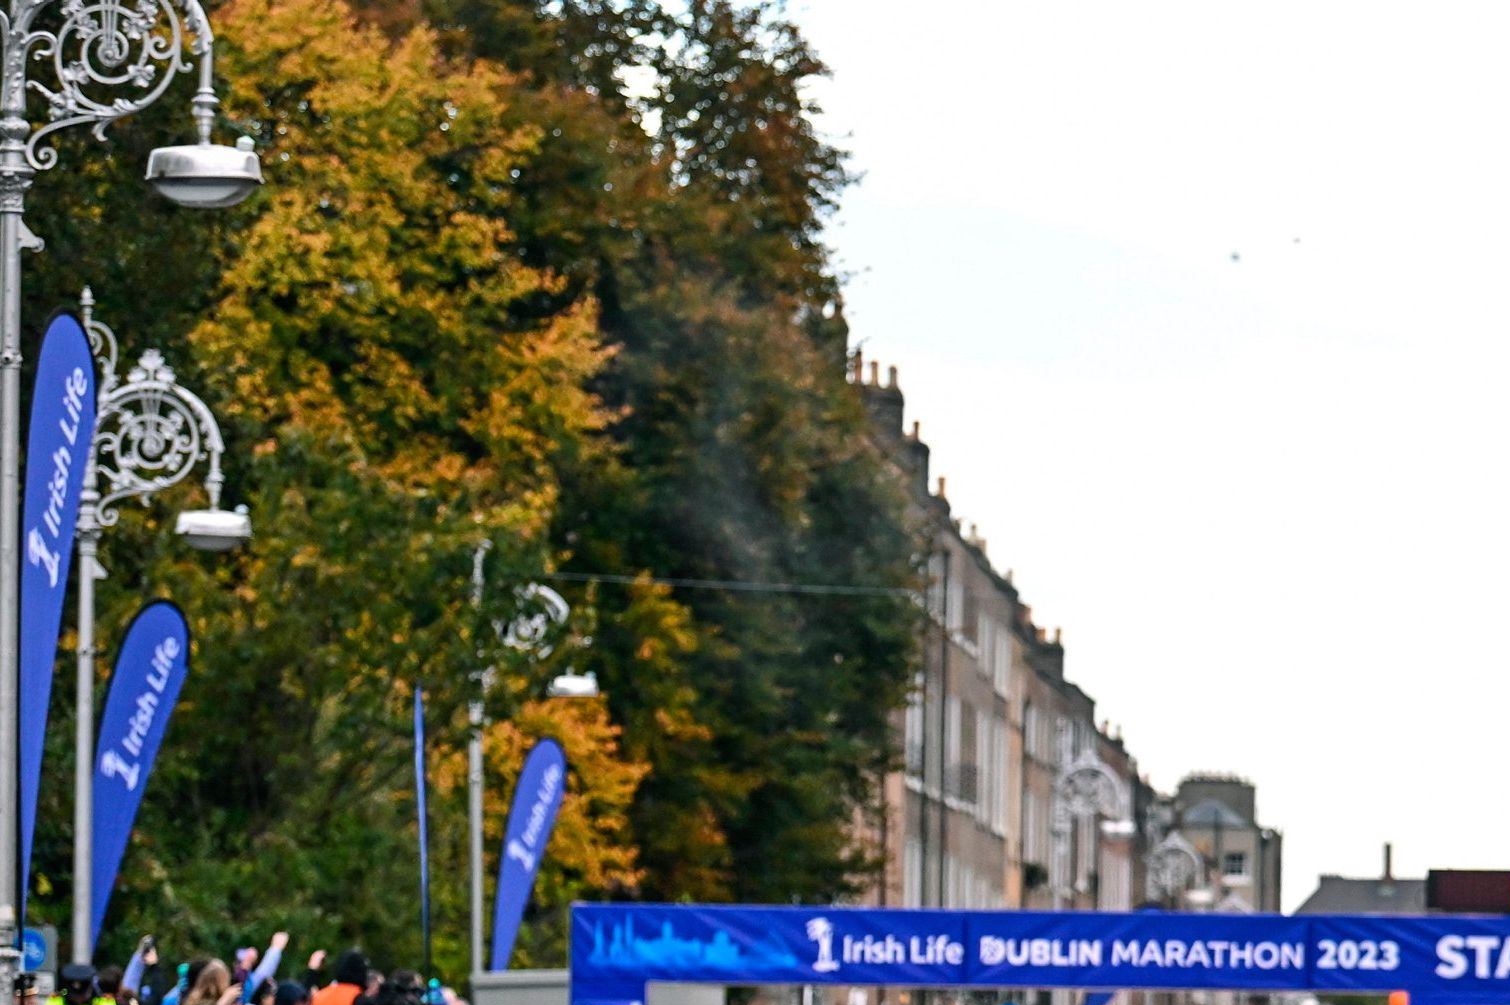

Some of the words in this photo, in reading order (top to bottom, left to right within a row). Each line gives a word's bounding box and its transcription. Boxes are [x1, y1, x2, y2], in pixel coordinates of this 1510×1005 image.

[43, 446, 72, 537] Irish
[61, 366, 89, 444] Life
[121, 690, 159, 757] Irish
[145, 635, 181, 696] Life
[842, 934, 905, 964] Irish
[909, 934, 964, 965] Life
[980, 938, 1103, 967] DUBLIN
[1110, 938, 1306, 970] MARATHON
[1316, 939, 1400, 971] 2023
